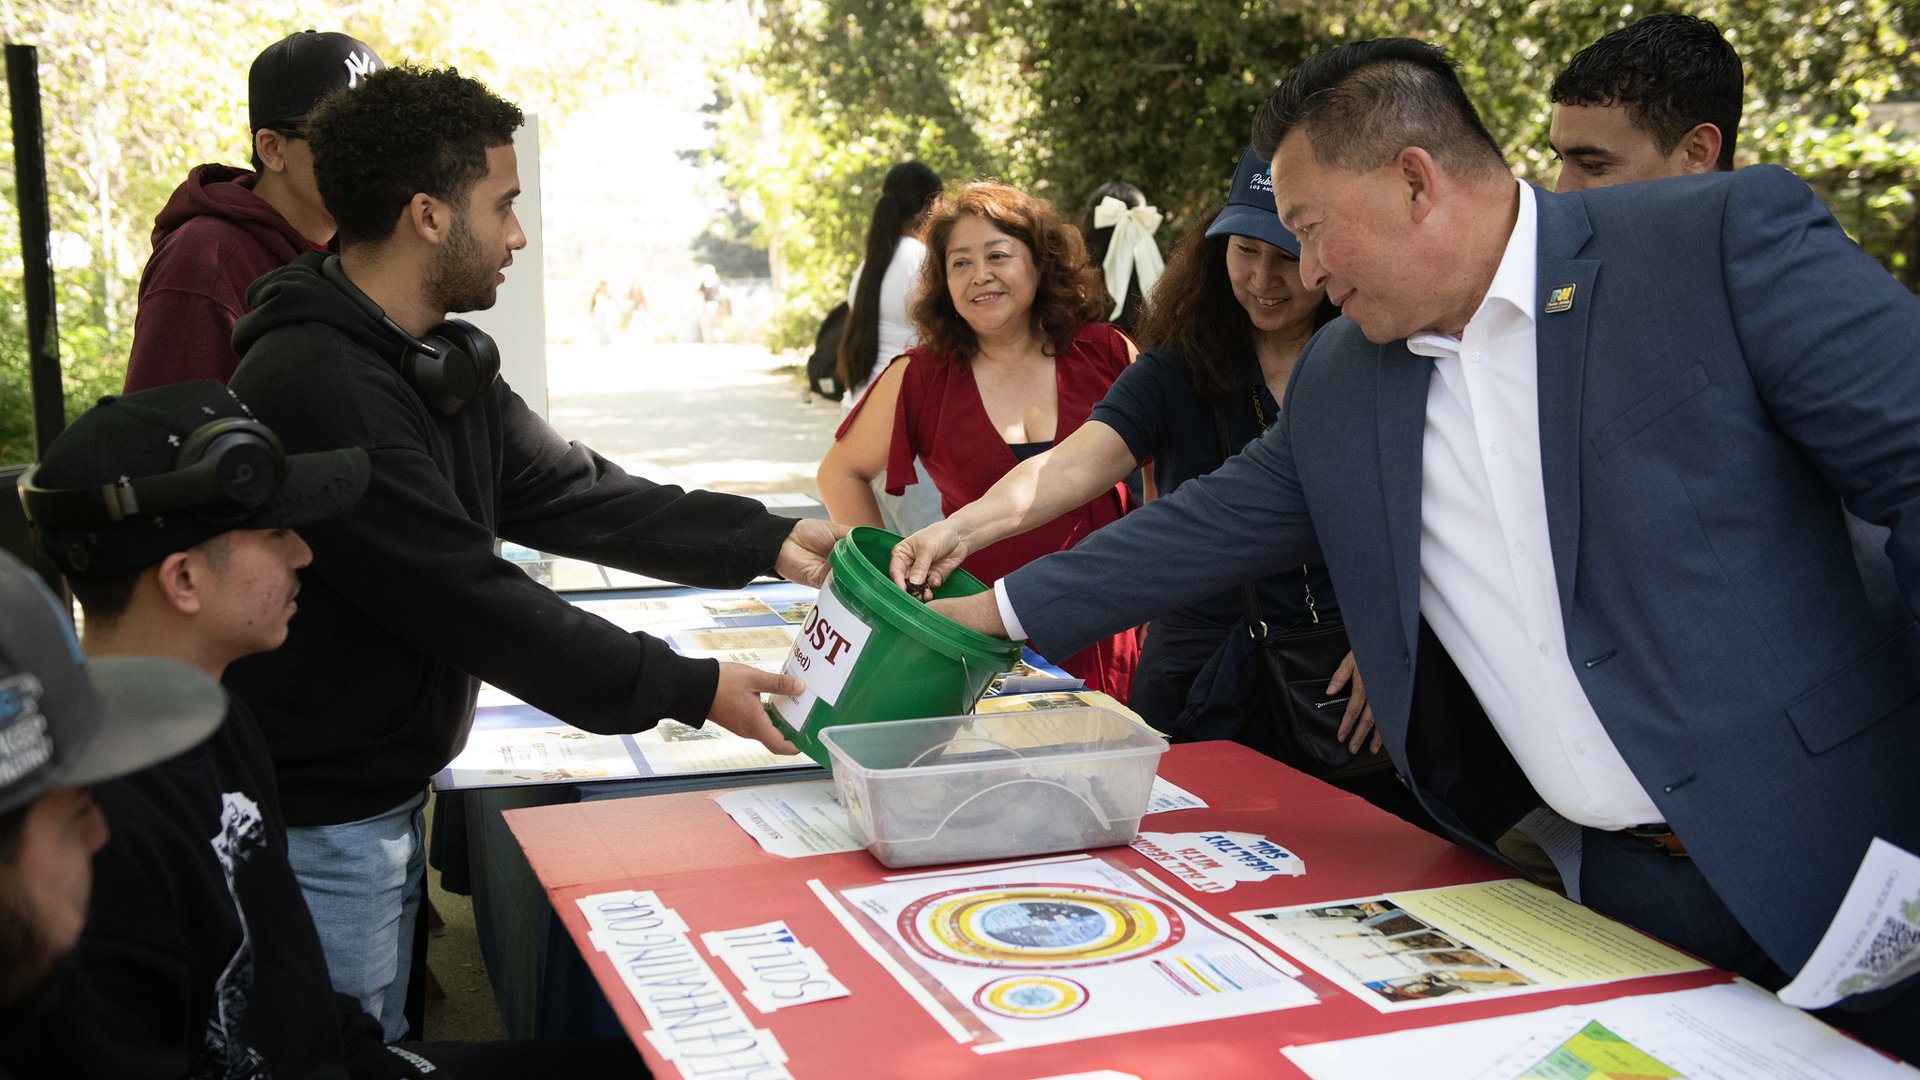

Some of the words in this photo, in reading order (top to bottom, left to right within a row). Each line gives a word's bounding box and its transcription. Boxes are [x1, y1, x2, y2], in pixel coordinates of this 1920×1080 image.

[1250, 174, 1273, 185] Pub
[1176, 848, 1223, 870] WITH
[1200, 835, 1280, 872] HEALTHY
[1249, 841, 1290, 860] SOIL
[1169, 862, 1207, 880] ALL
[1193, 881, 1225, 893] IT
[597, 896, 663, 931] OUR
